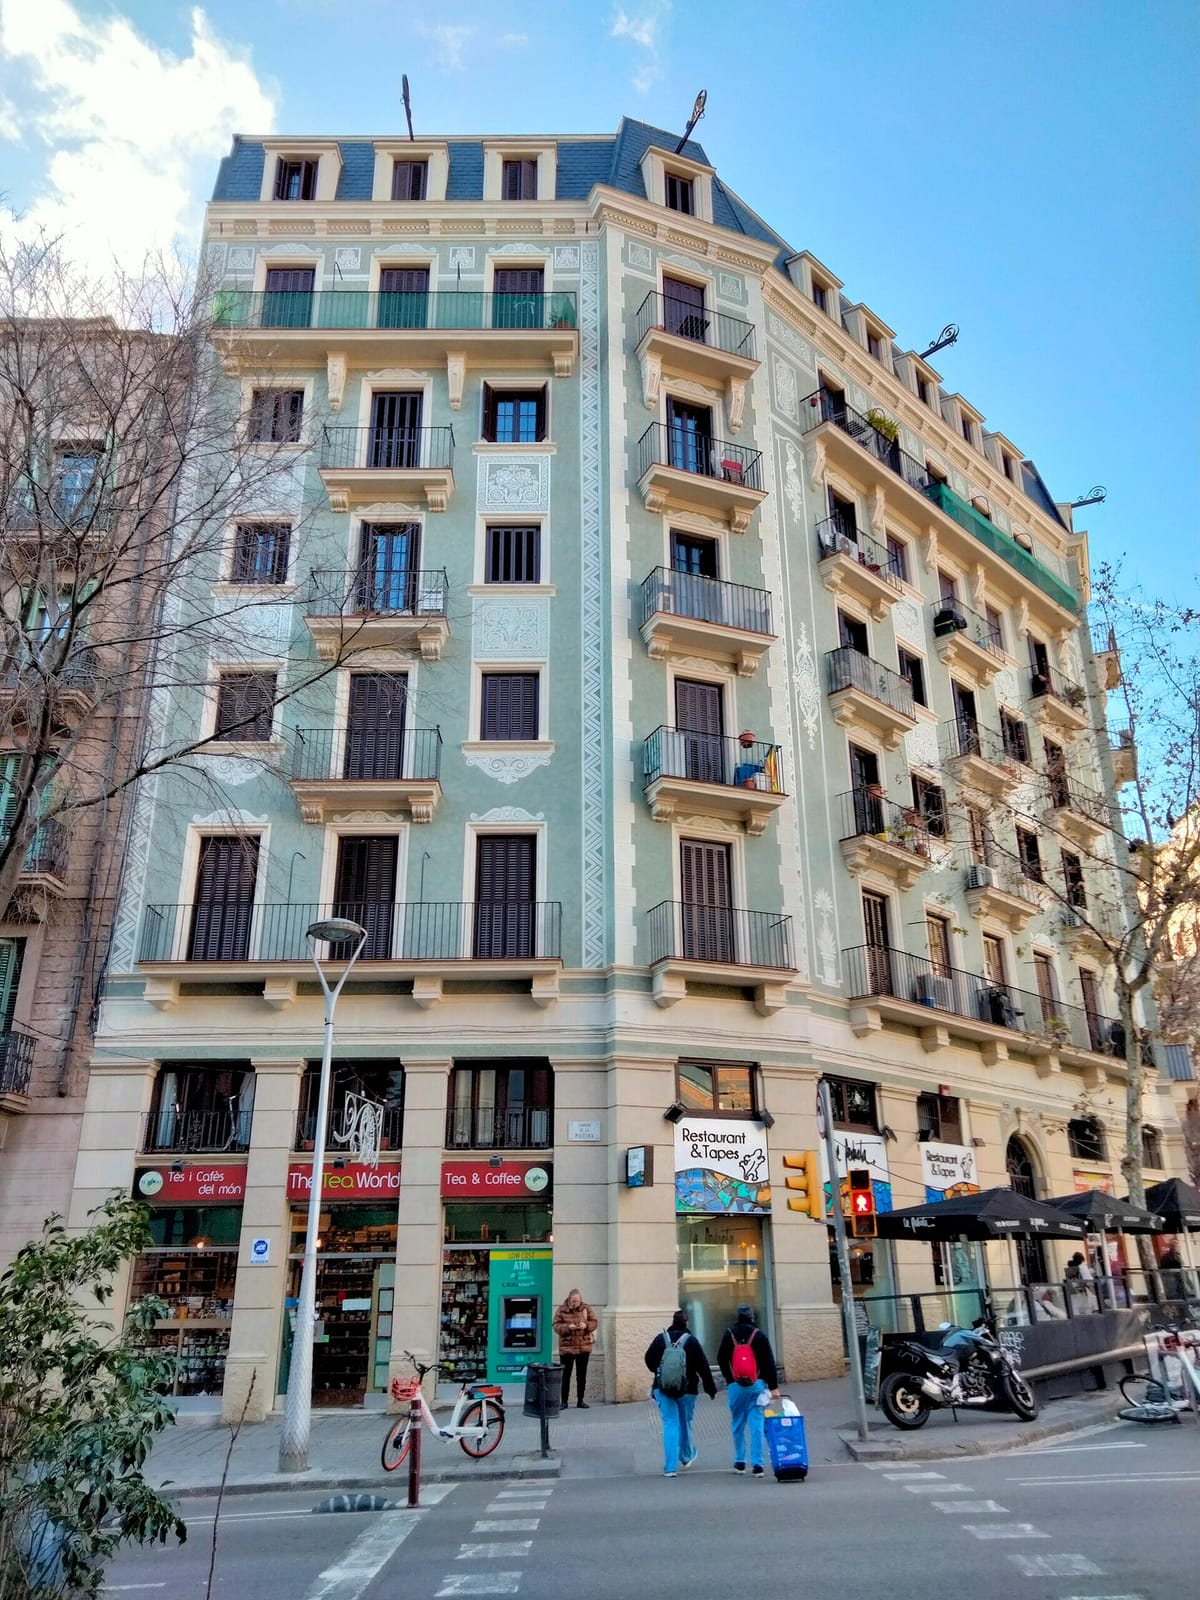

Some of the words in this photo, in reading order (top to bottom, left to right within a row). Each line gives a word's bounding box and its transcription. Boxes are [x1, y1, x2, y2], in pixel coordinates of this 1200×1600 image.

[682, 1127, 746, 1144] Restaurant
[926, 1150, 958, 1164] Restaurant
[168, 1171, 185, 1182] Tès
[189, 1171, 192, 1182] i
[196, 1171, 224, 1182] Cafès
[321, 1172, 354, 1188] Tea
[356, 1171, 400, 1188] World
[445, 1173, 467, 1185] Tea
[471, 1172, 480, 1185] &
[485, 1172, 521, 1184] Coffee
[198, 1184, 214, 1195] del
[218, 1185, 241, 1195] món
[513, 1260, 530, 1271] ATM
